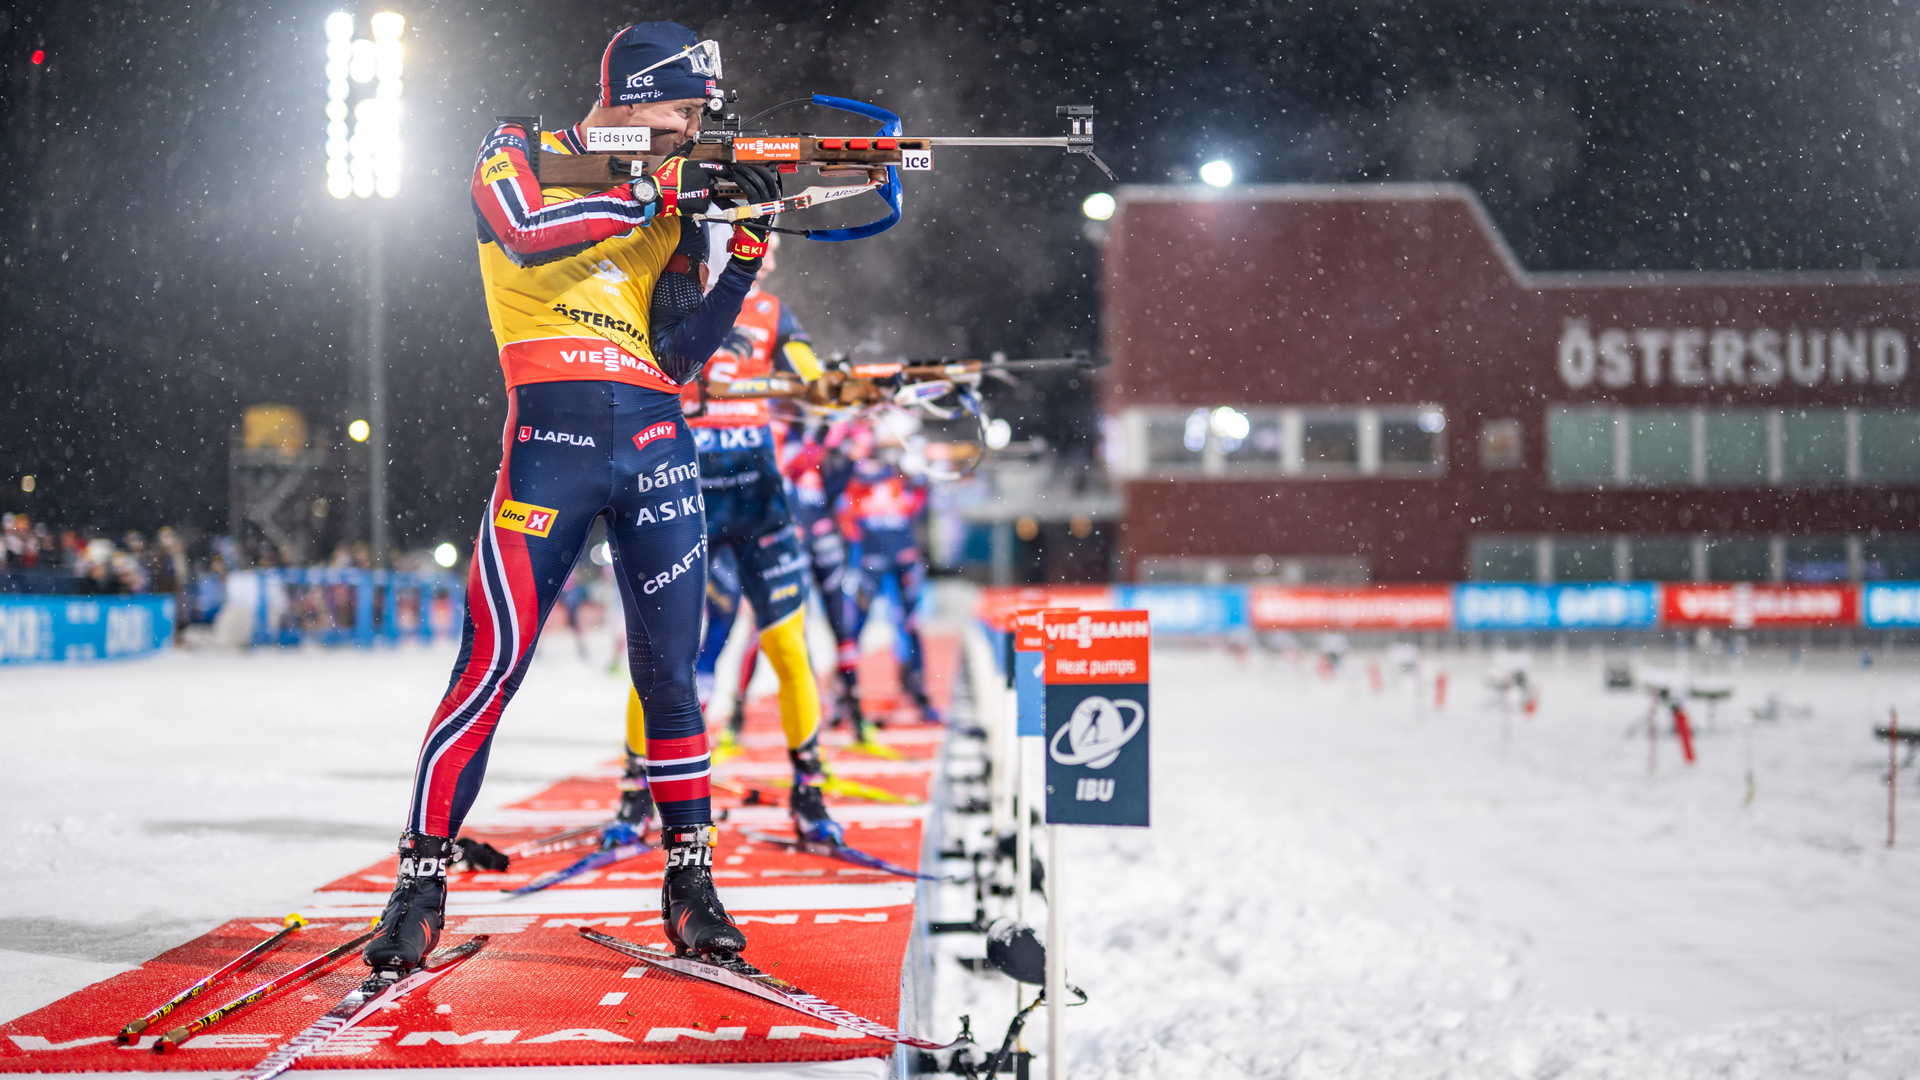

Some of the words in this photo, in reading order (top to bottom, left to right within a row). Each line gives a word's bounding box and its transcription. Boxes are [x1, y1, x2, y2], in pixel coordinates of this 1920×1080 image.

[625, 75, 655, 89] ice
[620, 91, 654, 101] CRAFT
[476, 136, 508, 164] RAFT
[735, 140, 799, 155] VIESSMANN
[904, 155, 929, 169] ice
[734, 242, 763, 255] LEKI
[603, 284, 621, 296] IBU
[1559, 317, 1908, 389] ÖSTERSUND
[534, 429, 596, 447] LAPUA
[638, 425, 673, 445] MENY
[502, 508, 526, 522] Uno
[527, 513, 549, 530] X
[643, 543, 703, 595] CRAFT
[1045, 616, 1149, 648] VIESSMANN
[1056, 659, 1088, 674] Heat
[1090, 660, 1137, 677] pumps
[1076, 778, 1116, 802] IBU
